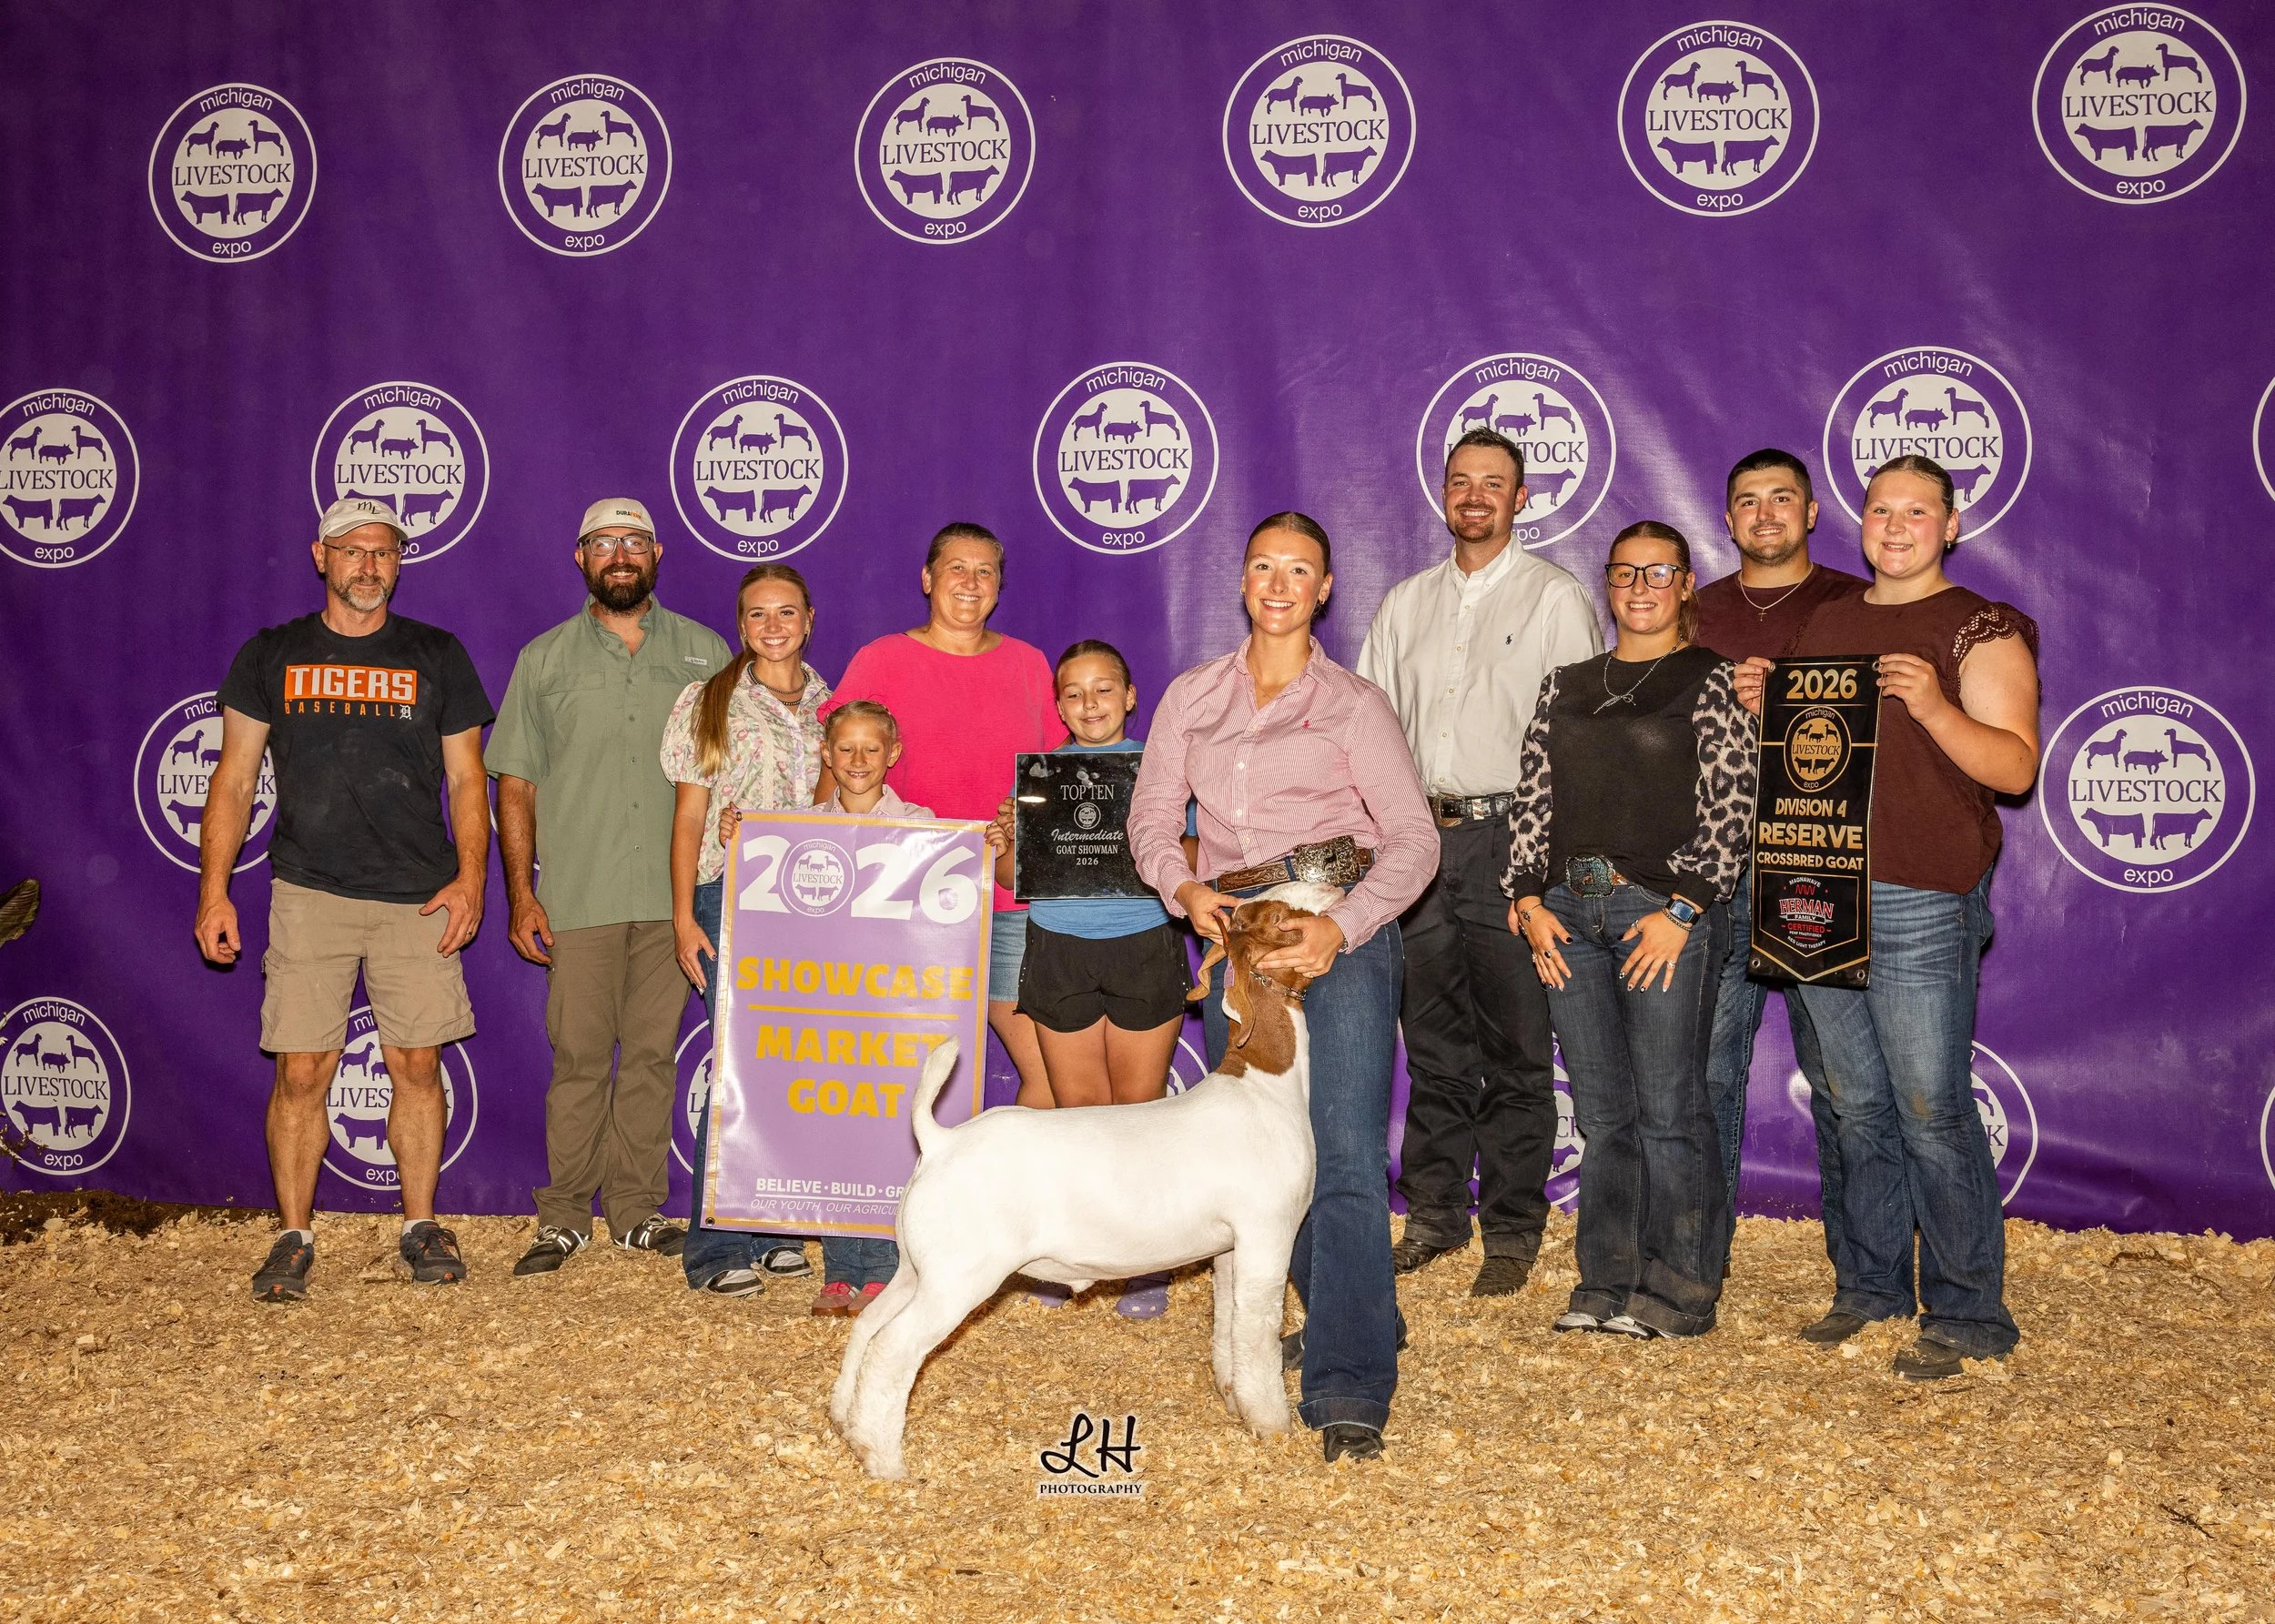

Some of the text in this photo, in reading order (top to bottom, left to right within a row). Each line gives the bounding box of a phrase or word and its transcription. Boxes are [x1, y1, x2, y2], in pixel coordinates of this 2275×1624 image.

[2093, 7, 2185, 36] michigan
[1676, 25, 1763, 52] michigan
[1280, 40, 1361, 66] michigan
[908, 63, 986, 88] michigan
[199, 88, 273, 112] michigan
[550, 79, 624, 103] michigan
[2065, 90, 2213, 118] LIVESTOCK
[1648, 107, 1788, 132] LIVESTOCK
[1251, 118, 1385, 146] LIVESTOCK
[882, 139, 1007, 165] LIVESTOCK
[174, 164, 291, 187] LIVESTOCK
[524, 154, 644, 179] LIVESTOCK
[2116, 177, 2166, 198] expo
[1696, 189, 1744, 211] expo
[1297, 201, 1342, 222] expo
[925, 218, 966, 239] expo
[212, 238, 251, 258] expo
[564, 231, 605, 252] expo
[1475, 358, 1561, 384] michigan
[1884, 352, 1972, 378] michigan
[1086, 367, 1166, 392] michigan
[364, 387, 441, 410] michigan
[722, 380, 799, 406] michigan
[23, 394, 95, 417] michigan
[1855, 436, 1999, 459] LIVESTOCK
[695, 459, 820, 481] LIVESTOCK
[1060, 448, 1189, 473] LIVESTOCK
[337, 463, 462, 485] LIVESTOCK
[737, 537, 779, 557] expo
[1102, 530, 1145, 550] expo
[35, 547, 74, 562] expo
[290, 667, 413, 701] TIGERS
[1786, 669, 1857, 700] 2026
[285, 700, 395, 717] BASEBALL
[1805, 708, 1835, 720] michigan
[2100, 691, 2194, 718] michigan
[1793, 744, 1840, 755] LIVESTOCK
[159, 774, 276, 794] LIVEK
[1060, 784, 1115, 801] TOP TEN
[2071, 780, 2221, 802] LIVESTOCK
[1775, 798, 1847, 817] DIVISION 4
[803, 840, 836, 852] michigan
[1051, 829, 1124, 842] Intermediate
[1759, 822, 1863, 849] RESERVE
[1057, 844, 1118, 854] GOAT SHOWMAN
[1757, 852, 1864, 870] CROSSBRED GOAT
[793, 873, 843, 884] LIVESTOCK
[1789, 877, 1821, 887] MAGNAWAVE
[2124, 866, 2173, 887] expo
[806, 906, 824, 914] expo
[1779, 898, 1835, 919] HERMAN
[1787, 923, 1825, 933] CERTIFIED
[736, 957, 974, 1000] SHOWCASE
[23, 1002, 86, 1026] michigan
[4, 1075, 108, 1100] LIVESTOCK
[787, 1078, 905, 1118] GOAT
[45, 1154, 83, 1170] expo
[756, 1177, 822, 1194] BELIEVE
[831, 1182, 876, 1197] BUILD
[751, 1199, 776, 1209] OUR
[826, 1203, 851, 1213] OUR
